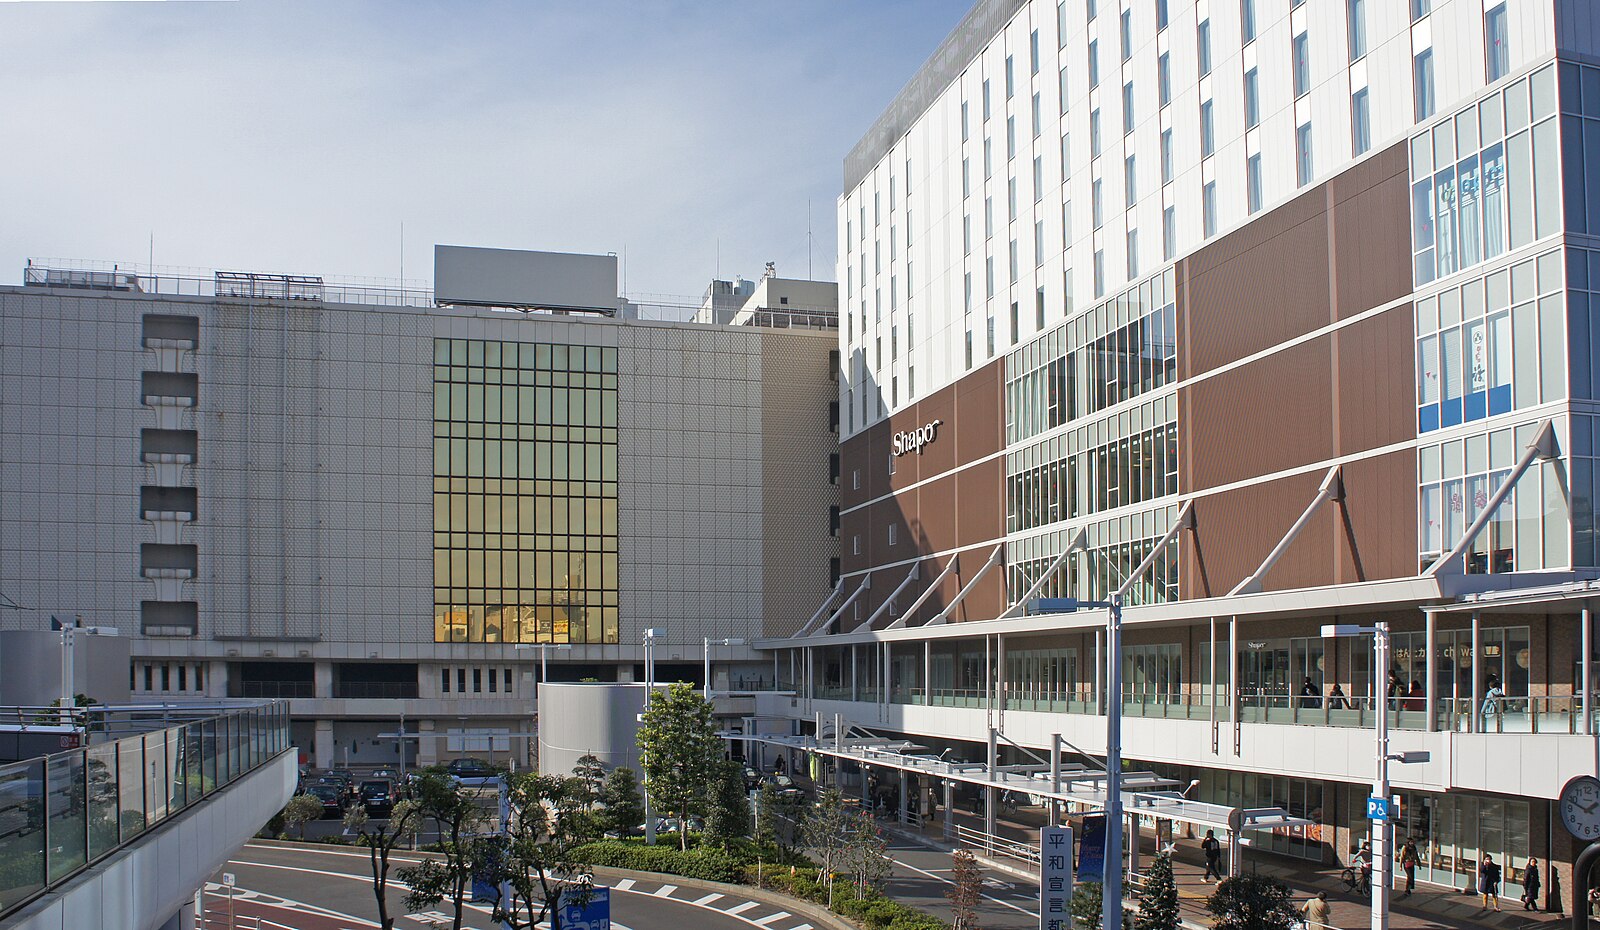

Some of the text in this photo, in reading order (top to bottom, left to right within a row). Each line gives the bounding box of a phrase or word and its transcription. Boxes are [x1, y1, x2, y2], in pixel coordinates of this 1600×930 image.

[1576, 789, 1582, 797] 11
[1584, 786, 1592, 795] 12
[1368, 801, 1377, 815] P
[1568, 804, 1573, 813] 9
[1570, 814, 1576, 823] 8
[1576, 822, 1582, 831] 7
[1584, 826, 1590, 835] 6
[1593, 824, 1599, 833] 5
